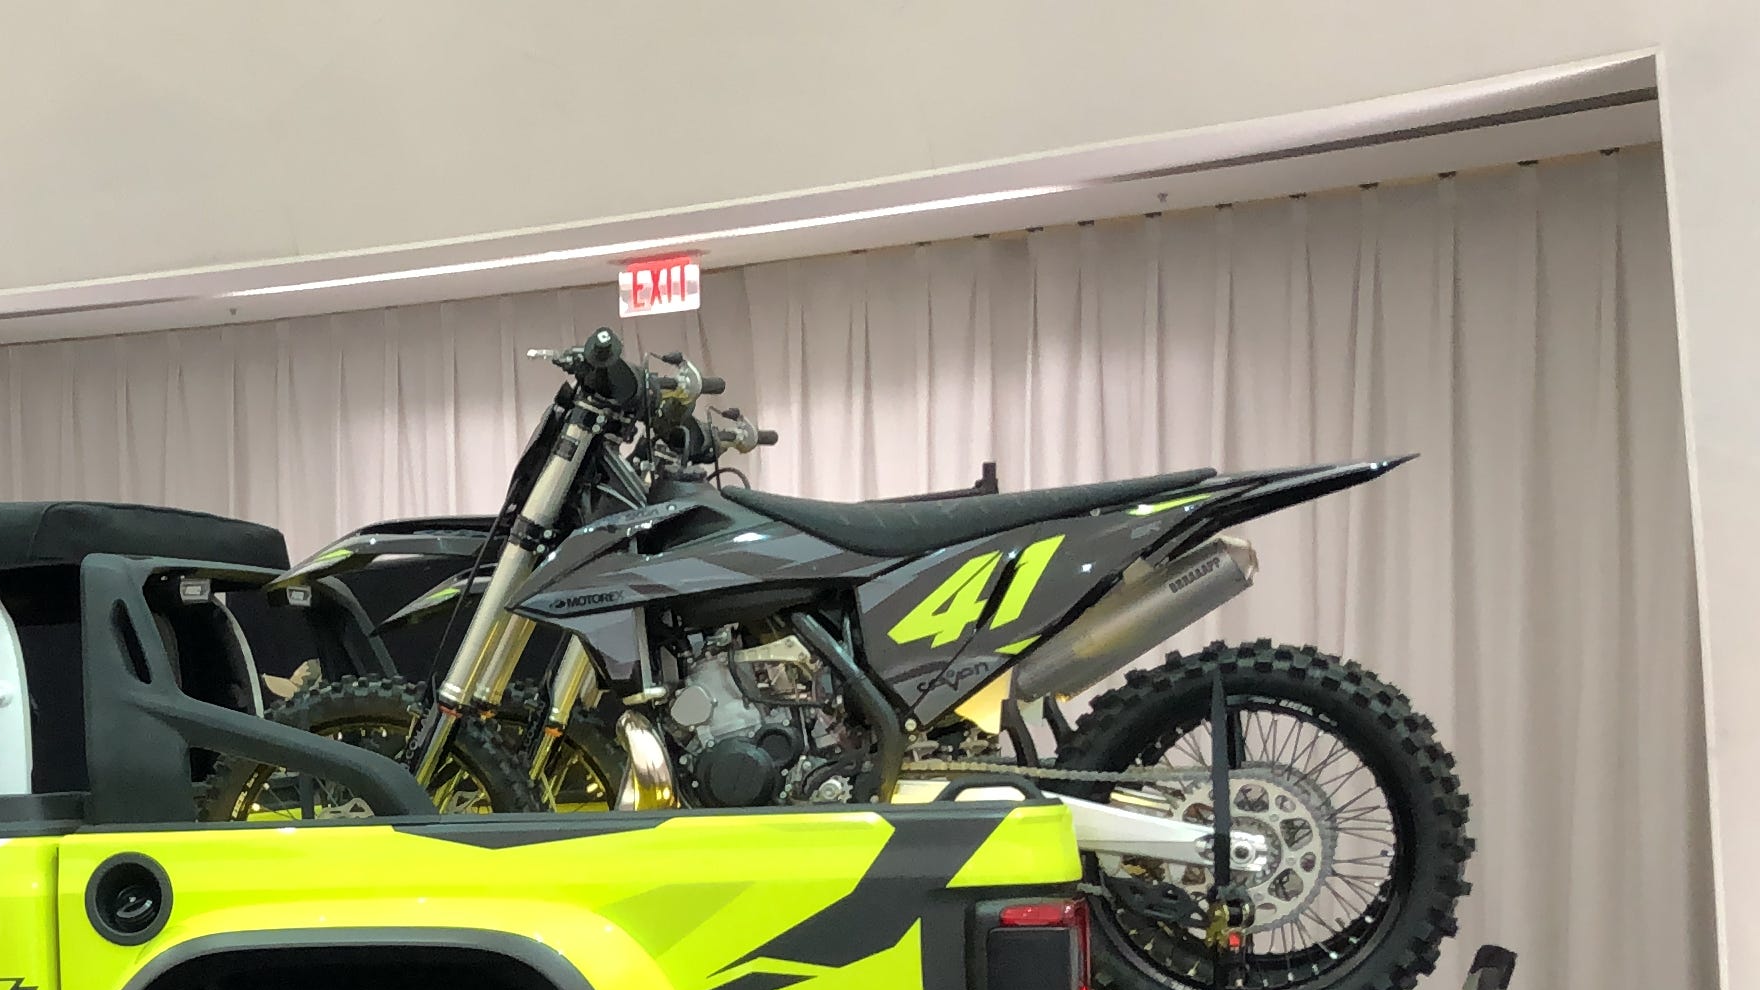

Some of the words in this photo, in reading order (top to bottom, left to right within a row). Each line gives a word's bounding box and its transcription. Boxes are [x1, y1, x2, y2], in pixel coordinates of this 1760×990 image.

[631, 259, 690, 308] EXIT
[565, 590, 625, 608] MOTOREX
[887, 534, 1066, 648] 41
